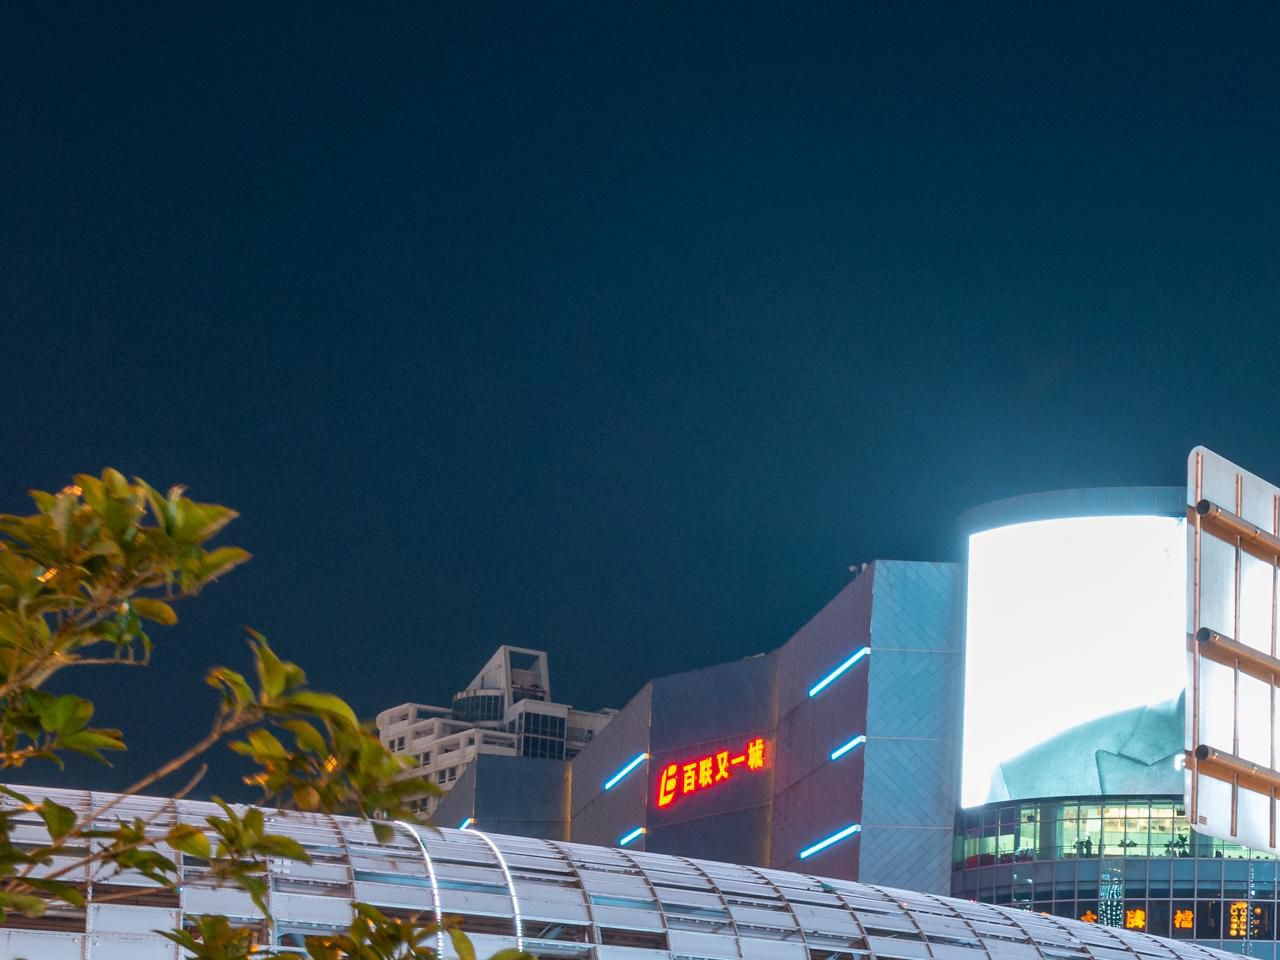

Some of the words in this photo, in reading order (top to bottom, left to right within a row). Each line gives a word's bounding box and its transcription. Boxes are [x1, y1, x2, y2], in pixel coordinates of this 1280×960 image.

[682, 738, 765, 794] 百联又一城
